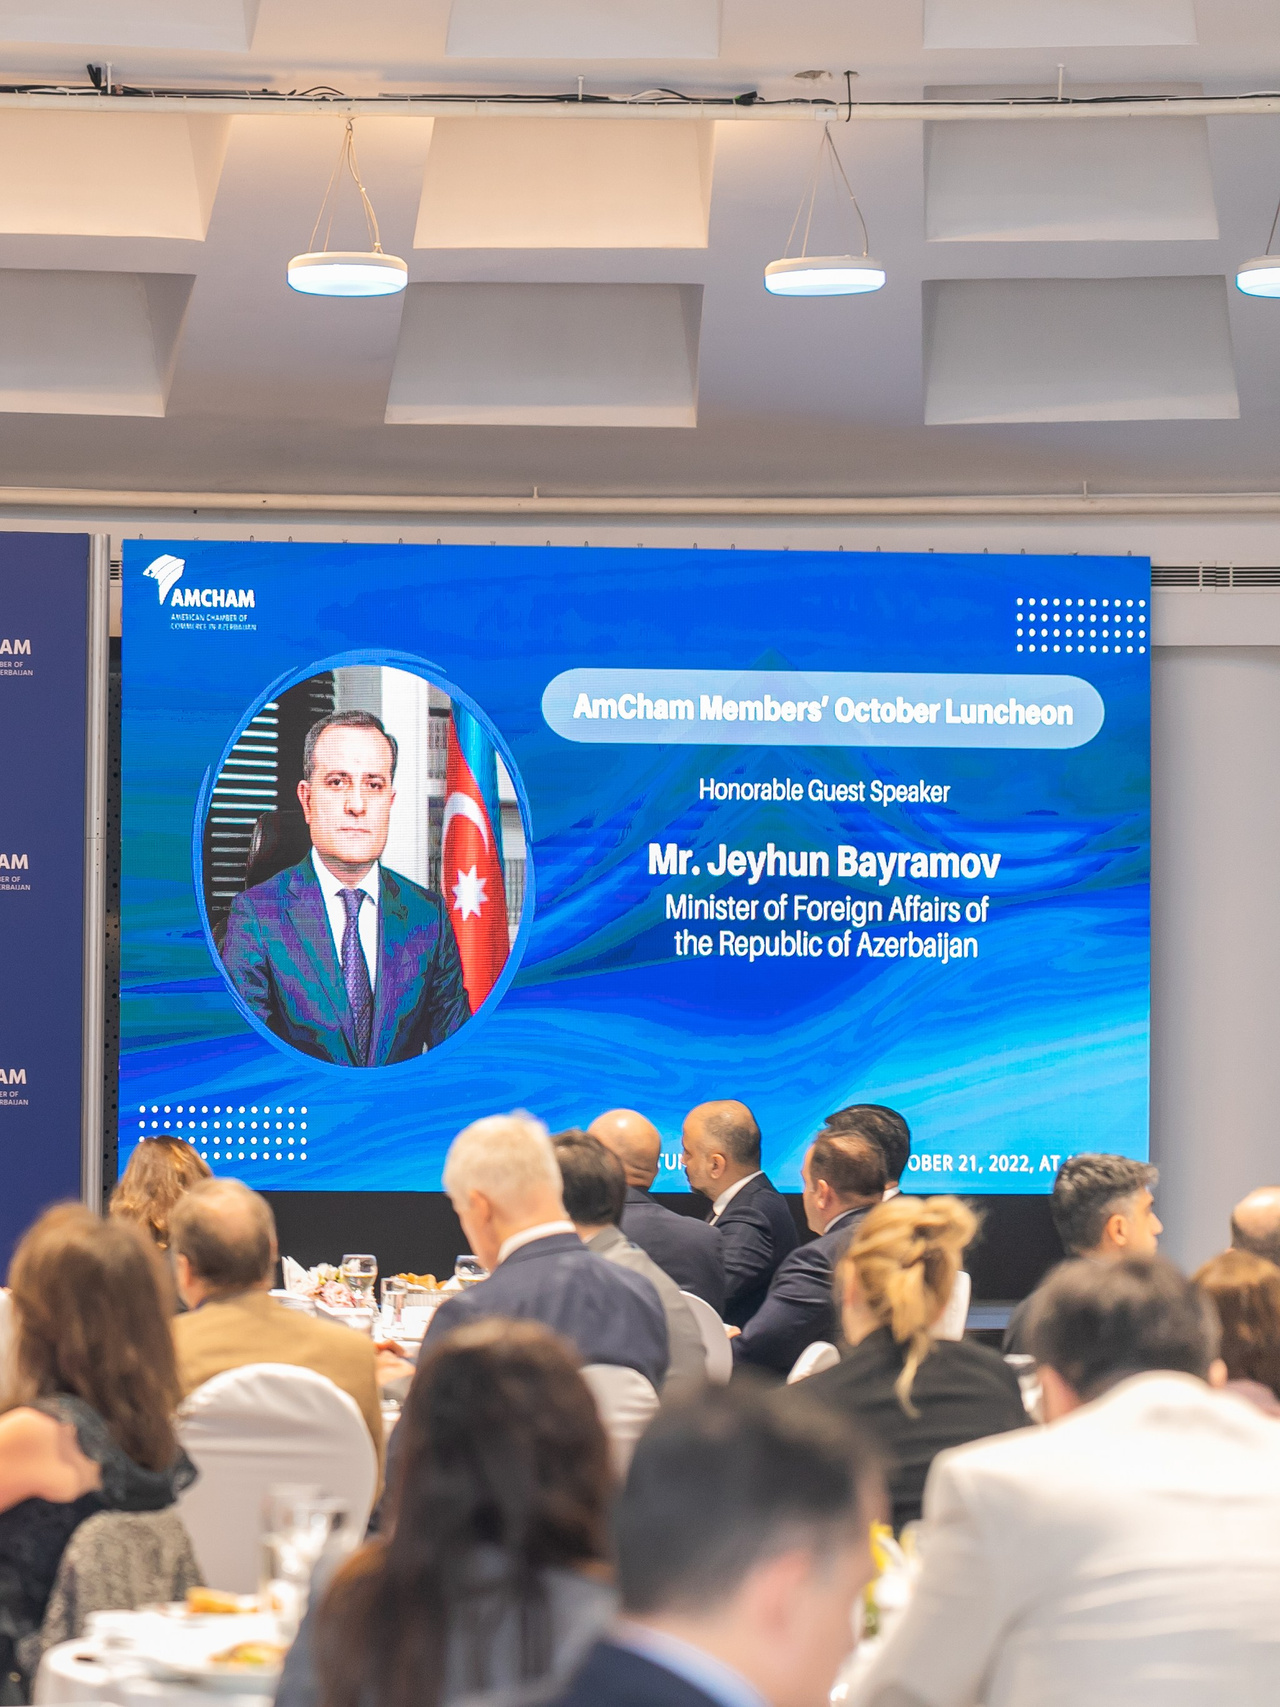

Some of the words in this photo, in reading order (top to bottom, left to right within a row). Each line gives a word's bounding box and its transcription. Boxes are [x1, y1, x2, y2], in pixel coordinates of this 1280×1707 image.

[171, 588, 256, 608] AMCHAM
[238, 614, 248, 622] OF
[14, 660, 23, 668] OF
[573, 692, 694, 720] AmCham
[834, 697, 941, 723] October
[945, 698, 1074, 726] Luncheon
[699, 777, 804, 801] Honorable
[808, 779, 866, 802] Guest
[870, 780, 951, 807] Speaker
[648, 843, 701, 876] Mr.
[706, 843, 830, 885] Jeyhun
[837, 845, 1002, 887] Bayramov
[11, 875, 20, 883] OF
[665, 893, 760, 921] Minister
[763, 893, 789, 921] of
[793, 895, 883, 928] Foreign
[888, 895, 961, 922] Affairs
[965, 895, 990, 923] of
[673, 929, 714, 956] the
[719, 929, 824, 963] Republic
[827, 929, 853, 958] of
[856, 931, 979, 965] Azerbaijan
[9, 1090, 18, 1098] OF
[907, 1154, 953, 1172] OBER
[958, 1154, 983, 1174] 21,
[988, 1154, 1034, 1174] 2022,
[1039, 1155, 1061, 1172] AT
